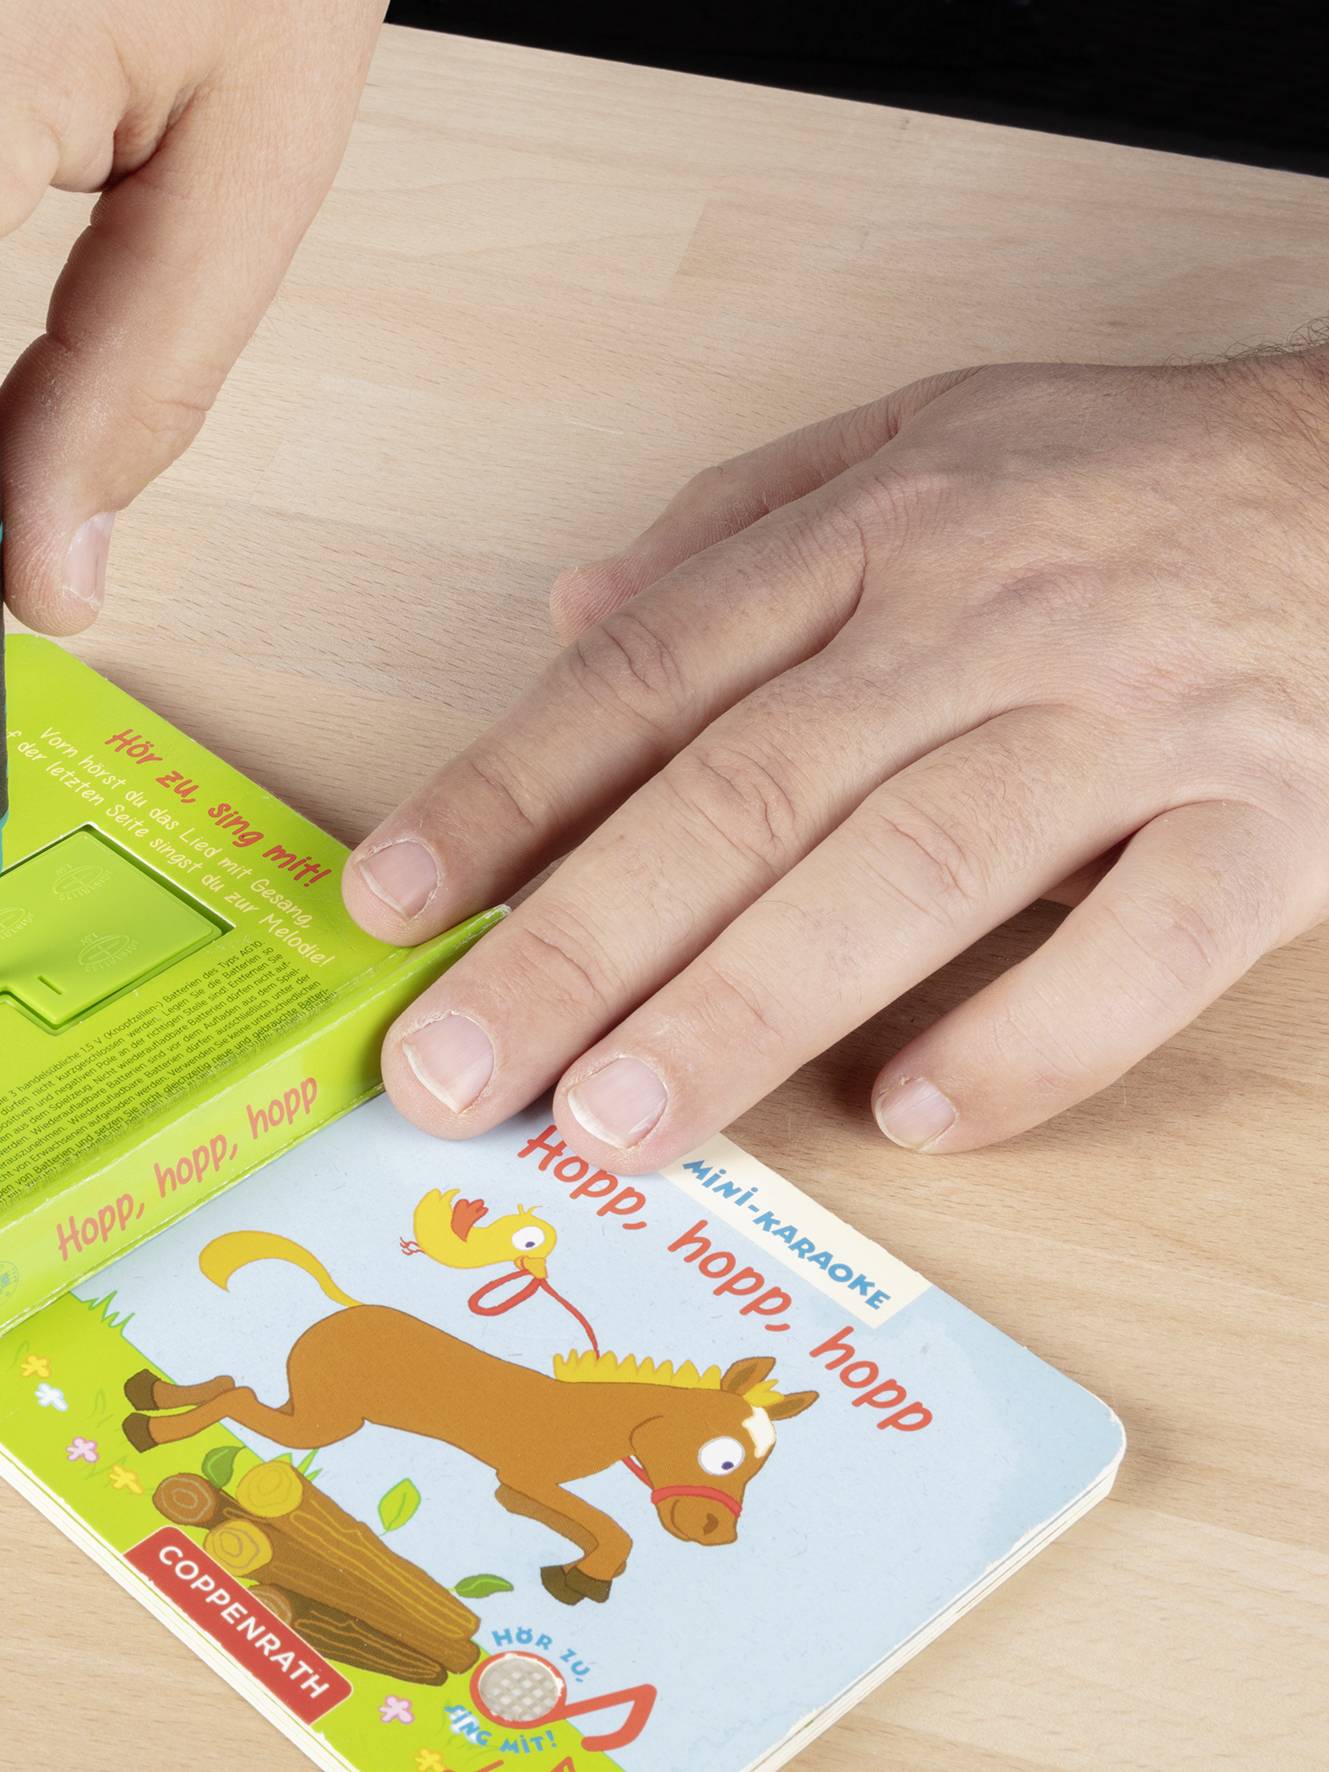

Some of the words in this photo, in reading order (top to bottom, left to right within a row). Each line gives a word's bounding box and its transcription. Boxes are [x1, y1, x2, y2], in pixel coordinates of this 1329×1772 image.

[17, 738, 48, 764] der
[46, 761, 107, 806] letzten
[106, 802, 151, 837] Seite
[147, 838, 205, 875] singst
[199, 871, 226, 892] du
[224, 892, 259, 912] zur
[258, 912, 335, 968] Melodie!
[40, 727, 78, 758] Vorn
[78, 755, 128, 791] hörst
[121, 787, 149, 808] du
[145, 804, 181, 831] das
[179, 827, 224, 858] Lied
[217, 857, 256, 879] mit
[250, 878, 315, 928] Gesang,
[105, 726, 163, 772] Hör
[155, 770, 199, 803] zu,
[208, 800, 264, 848] sing
[260, 841, 334, 887] mit!
[55, 1193, 146, 1262] Hopp,
[153, 1133, 239, 1199] hopp,
[245, 1076, 319, 1140] hopp
[517, 1124, 647, 1230] Hopp,
[667, 1219, 793, 1332] hopp,
[808, 1325, 933, 1432] hopp
[158, 1544, 329, 1700] COPPENRATH
[492, 1626, 553, 1650] HÖR
[560, 1648, 591, 1682] ZU,
